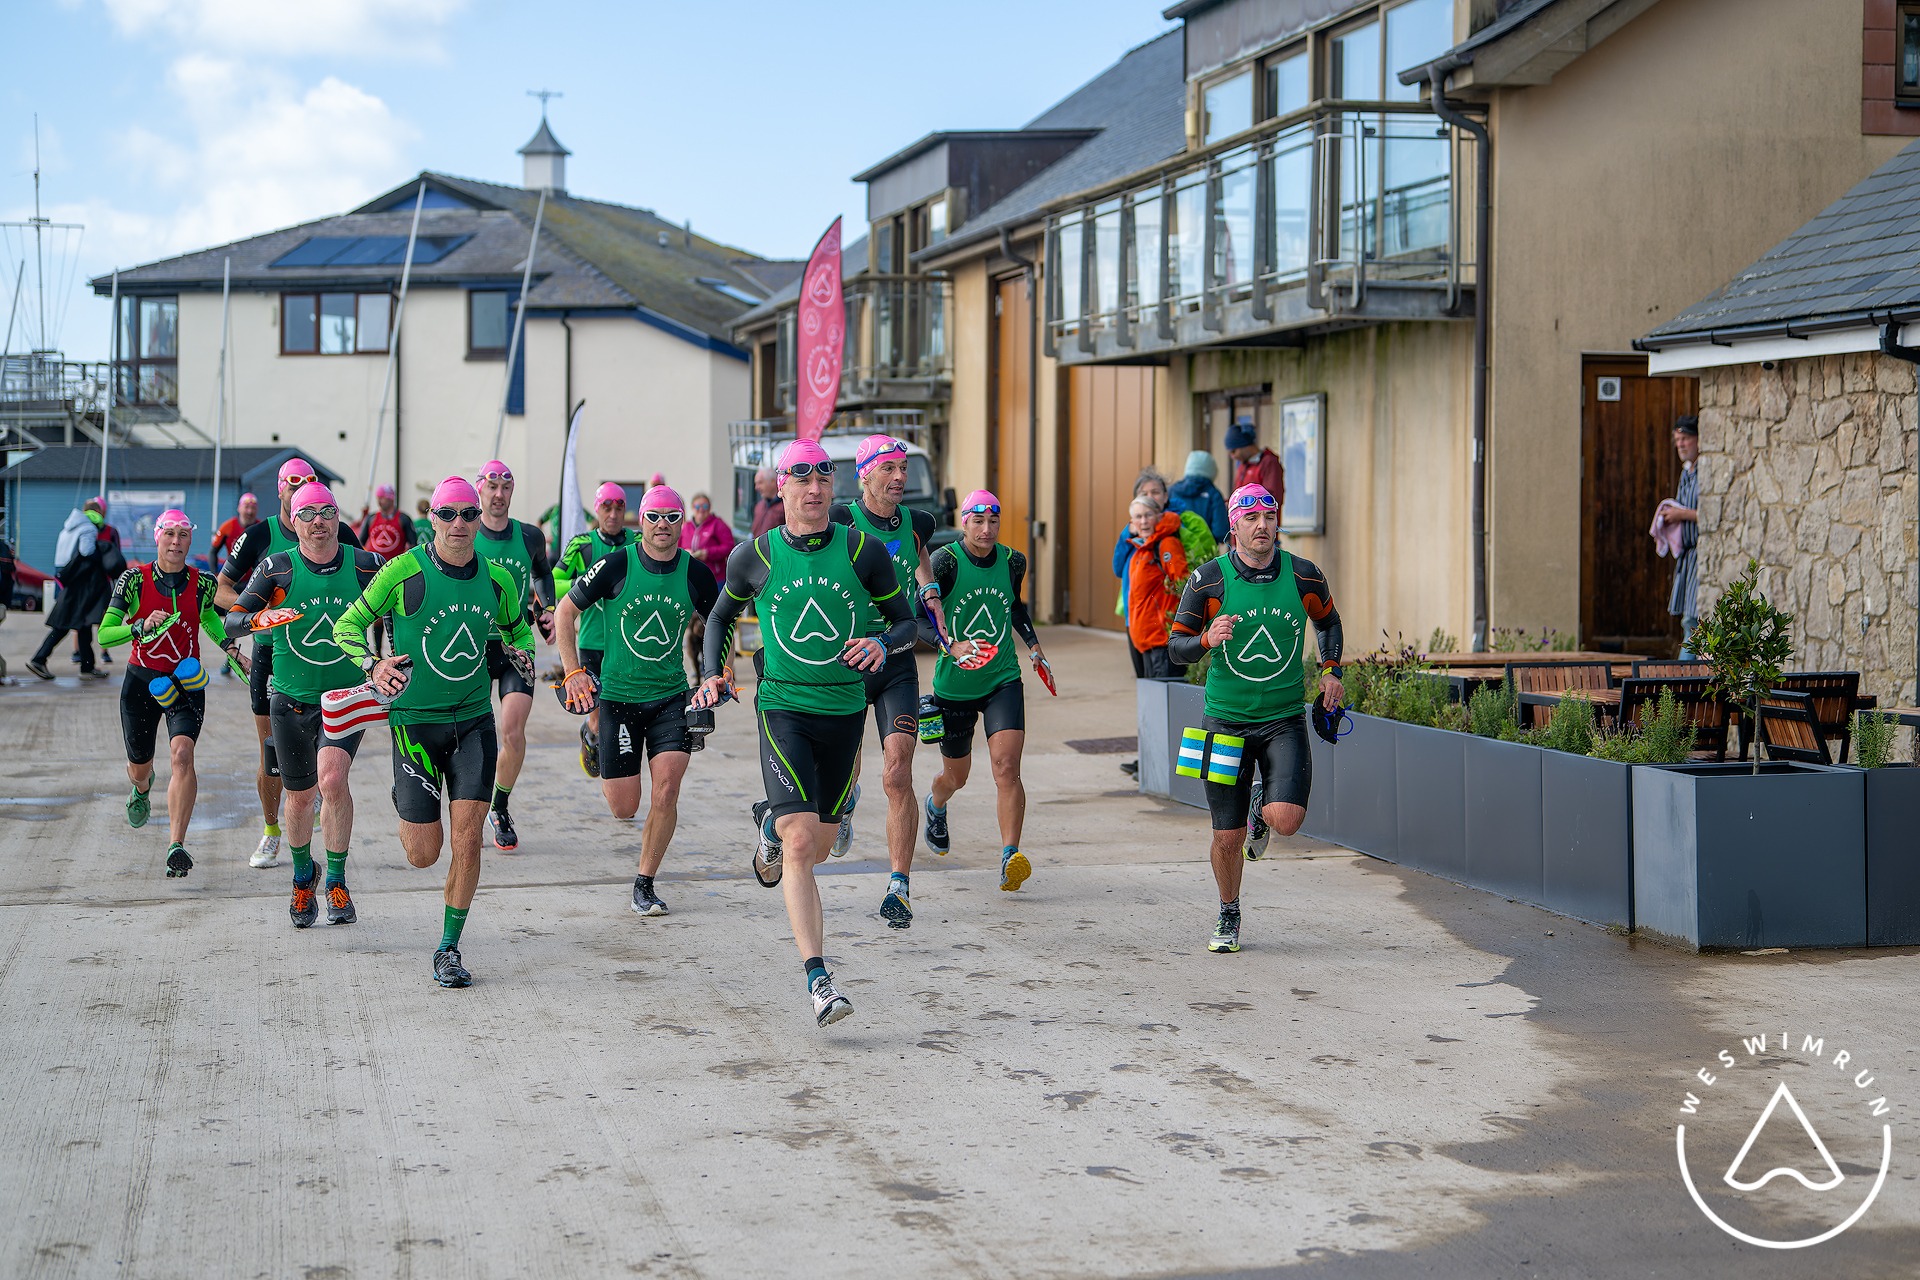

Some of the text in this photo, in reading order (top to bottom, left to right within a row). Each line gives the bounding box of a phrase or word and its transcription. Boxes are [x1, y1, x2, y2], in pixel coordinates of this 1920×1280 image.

[807, 538, 822, 546] SR
[582, 558, 607, 587] ARK
[621, 594, 686, 623] WESWIMRUN
[770, 576, 856, 613] WESWIMRUN
[954, 587, 1010, 614] WESWIMRUN
[1237, 606, 1301, 636] SWIMRUN
[618, 723, 633, 755] ARK
[402, 762, 441, 801] orca
[768, 755, 795, 793] YONDA
